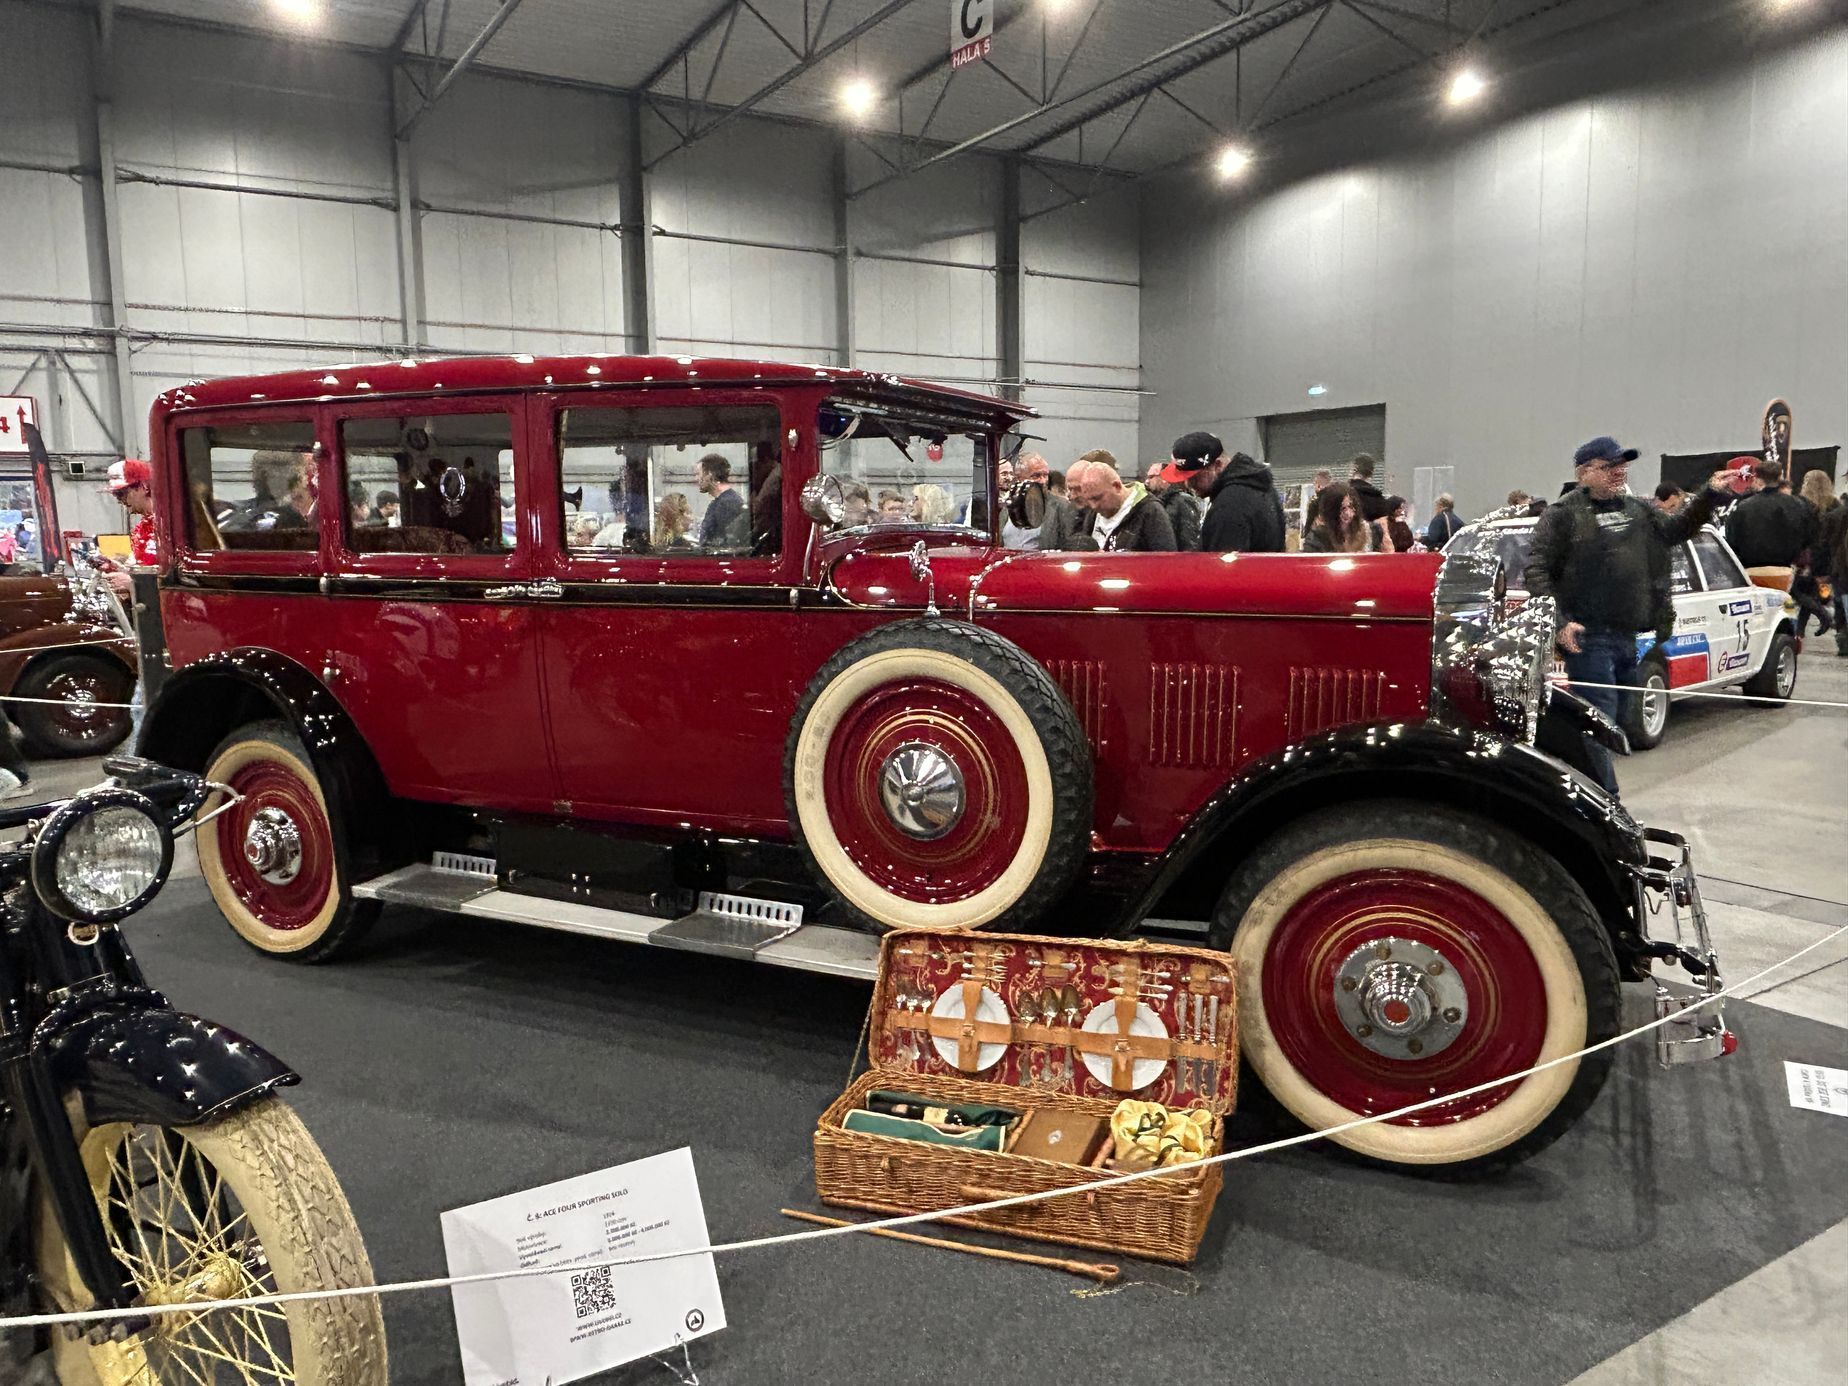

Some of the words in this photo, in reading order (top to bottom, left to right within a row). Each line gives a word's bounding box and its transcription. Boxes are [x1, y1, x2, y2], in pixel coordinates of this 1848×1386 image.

[960, 0, 983, 39] C
[952, 42, 981, 69] HALA
[1735, 618, 1749, 653] 15
[543, 1208, 557, 1218] ACE
[557, 1202, 577, 1214] FOUR
[577, 1193, 611, 1209] SPORTING
[611, 1188, 629, 1199] SOLO
